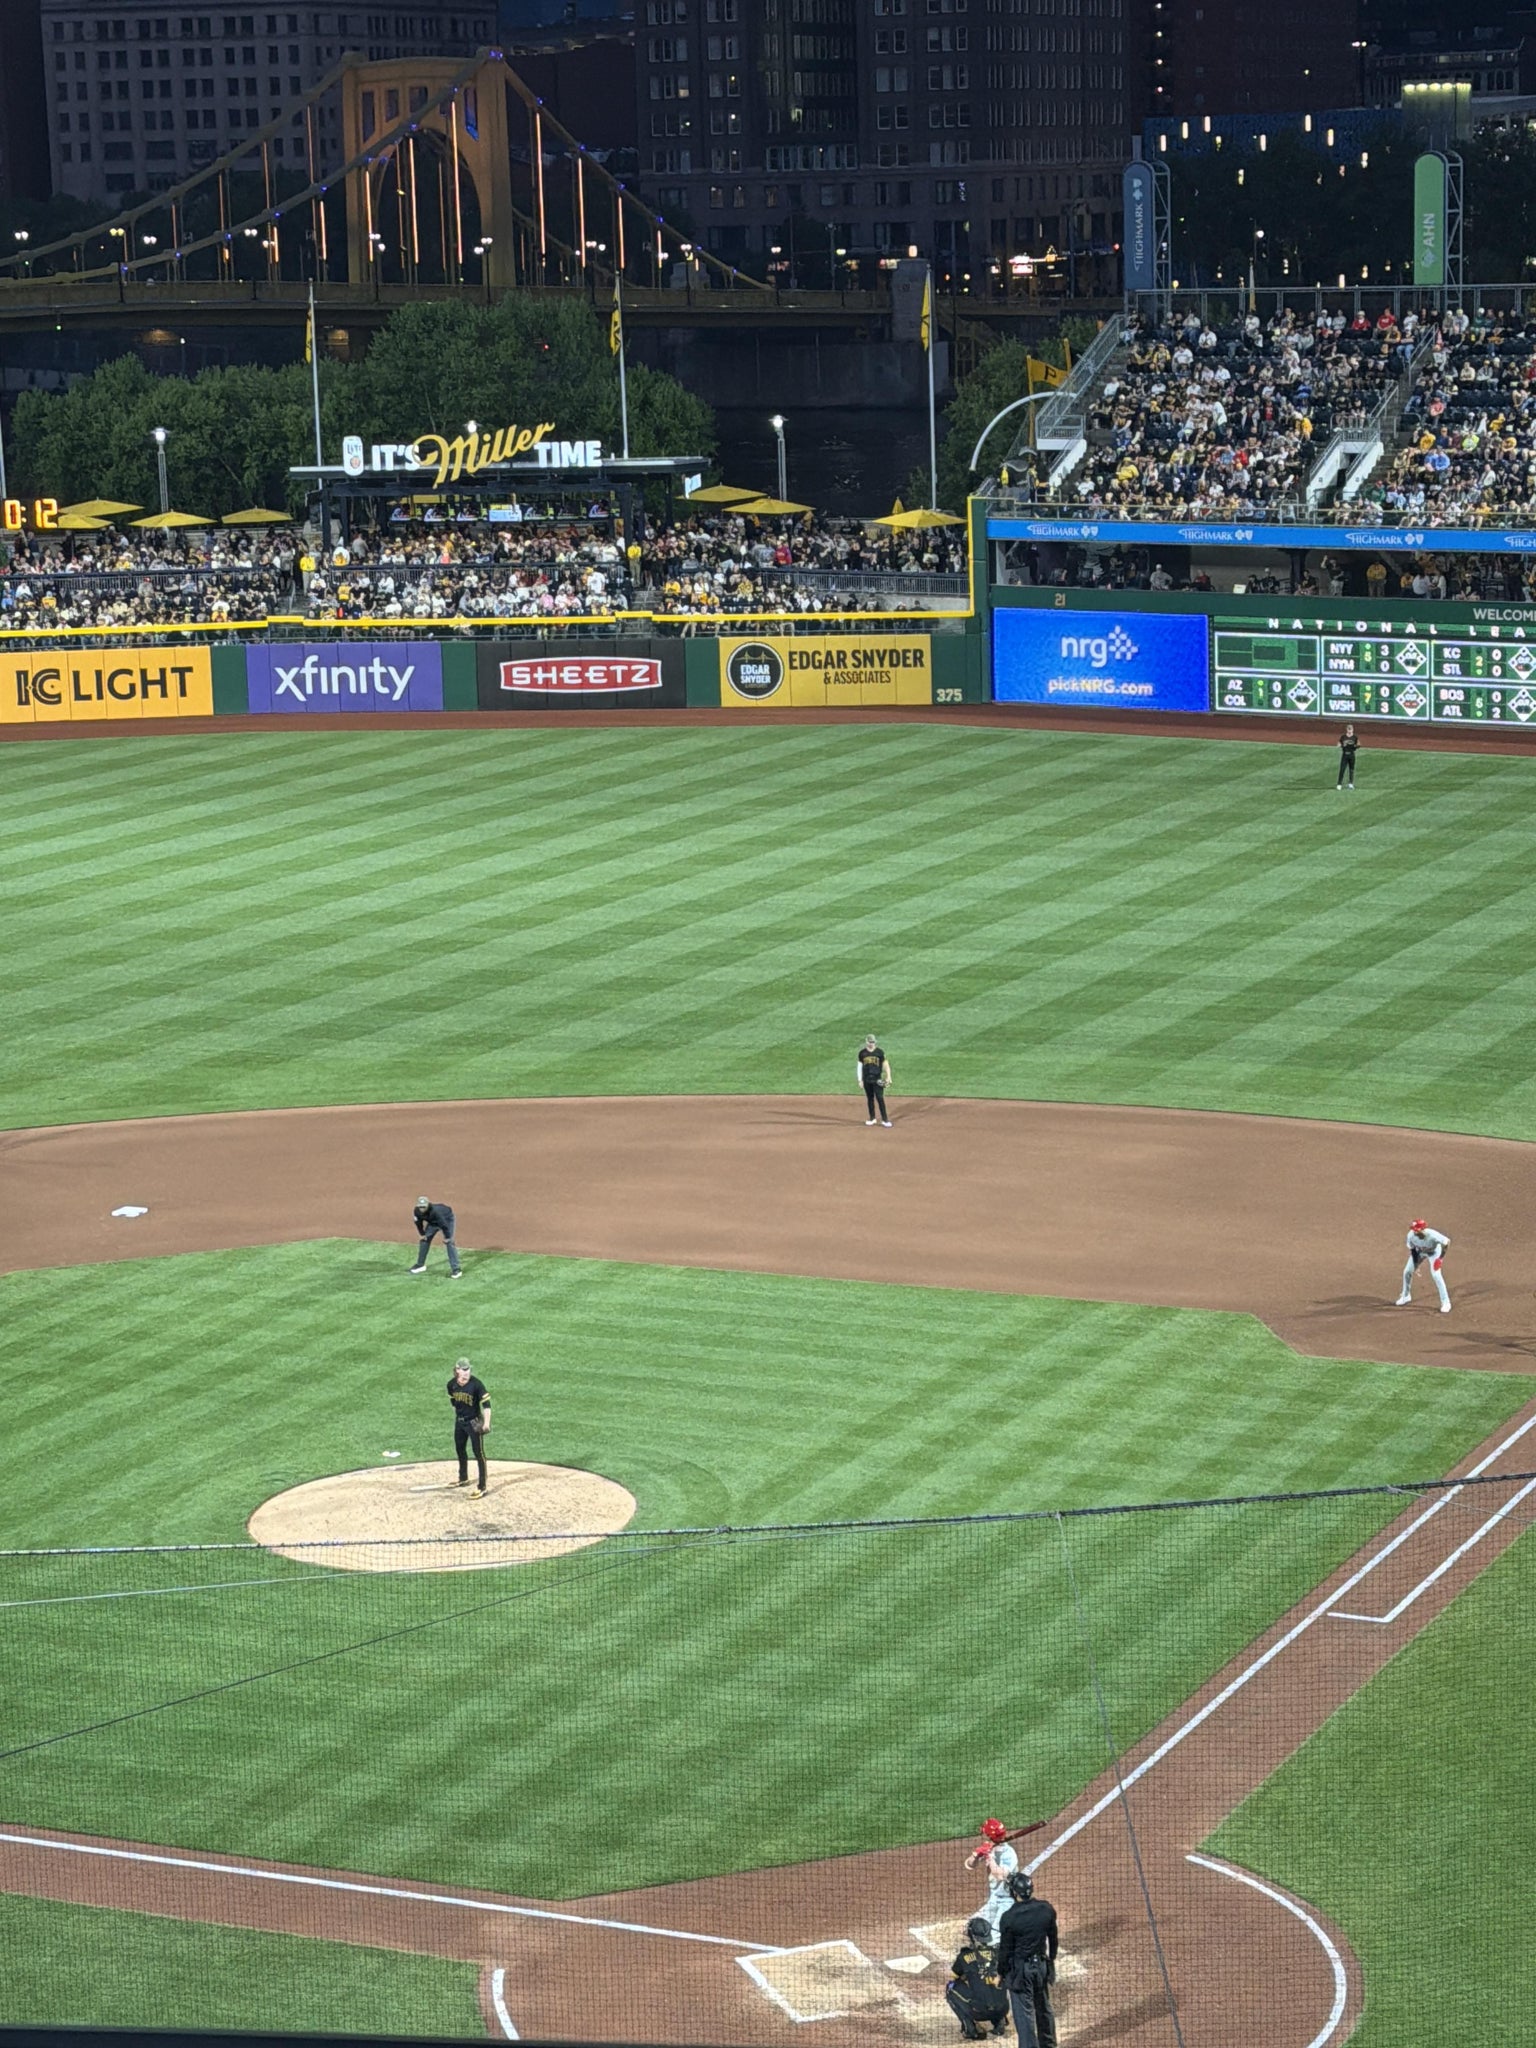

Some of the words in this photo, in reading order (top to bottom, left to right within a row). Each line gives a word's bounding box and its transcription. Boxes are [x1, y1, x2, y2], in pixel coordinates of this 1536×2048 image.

[1133, 203, 1144, 271] HIGHMARK
[1423, 213, 1435, 247] AHN
[372, 444, 420, 471] IT'S
[412, 422, 555, 489] Miller
[534, 440, 602, 468] TIME
[4, 498, 58, 529] 0:12
[1026, 524, 1080, 537] HIGHMARK
[1178, 528, 1233, 541] HIGHMARK
[1345, 532, 1403, 545] HIGHMARK
[1054, 593, 1066, 607] 21
[1268, 618, 1438, 635] NATIONAL
[1061, 636, 1108, 668] nrg
[1329, 643, 1354, 656] NYY
[1380, 644, 1390, 657] 3
[1442, 647, 1462, 660] KC
[1492, 648, 1502, 661] 0
[788, 649, 848, 670] EDGAR
[851, 649, 924, 669] SNYDER
[1328, 659, 1355, 671] NYM
[1380, 660, 1390, 672] 0
[1475, 656, 1483, 667] 2
[511, 664, 651, 685] SHEETZ
[740, 664, 770, 675] EDGAR
[1442, 663, 1462, 676] STL
[1492, 664, 1502, 677] 0
[72, 666, 194, 701] LIGHT
[275, 654, 415, 701] xfinity
[740, 675, 771, 684] SNYDER
[824, 671, 831, 685] &
[834, 670, 892, 685] ASSOCIATES
[1048, 676, 1154, 696] pickNRG.com
[1227, 679, 1243, 691] AZ
[1272, 682, 1282, 693] 0
[1331, 684, 1352, 696] BAL
[1380, 686, 1390, 698] 0
[936, 688, 963, 702] 375
[1223, 694, 1247, 706] COL
[1272, 697, 1282, 709] 0
[1439, 688, 1464, 701] BOS
[1492, 690, 1502, 703] 0
[1328, 699, 1355, 712] WSH
[1380, 701, 1390, 713] 3
[1442, 704, 1462, 717] ATL
[1491, 710, 1501, 719] 2
